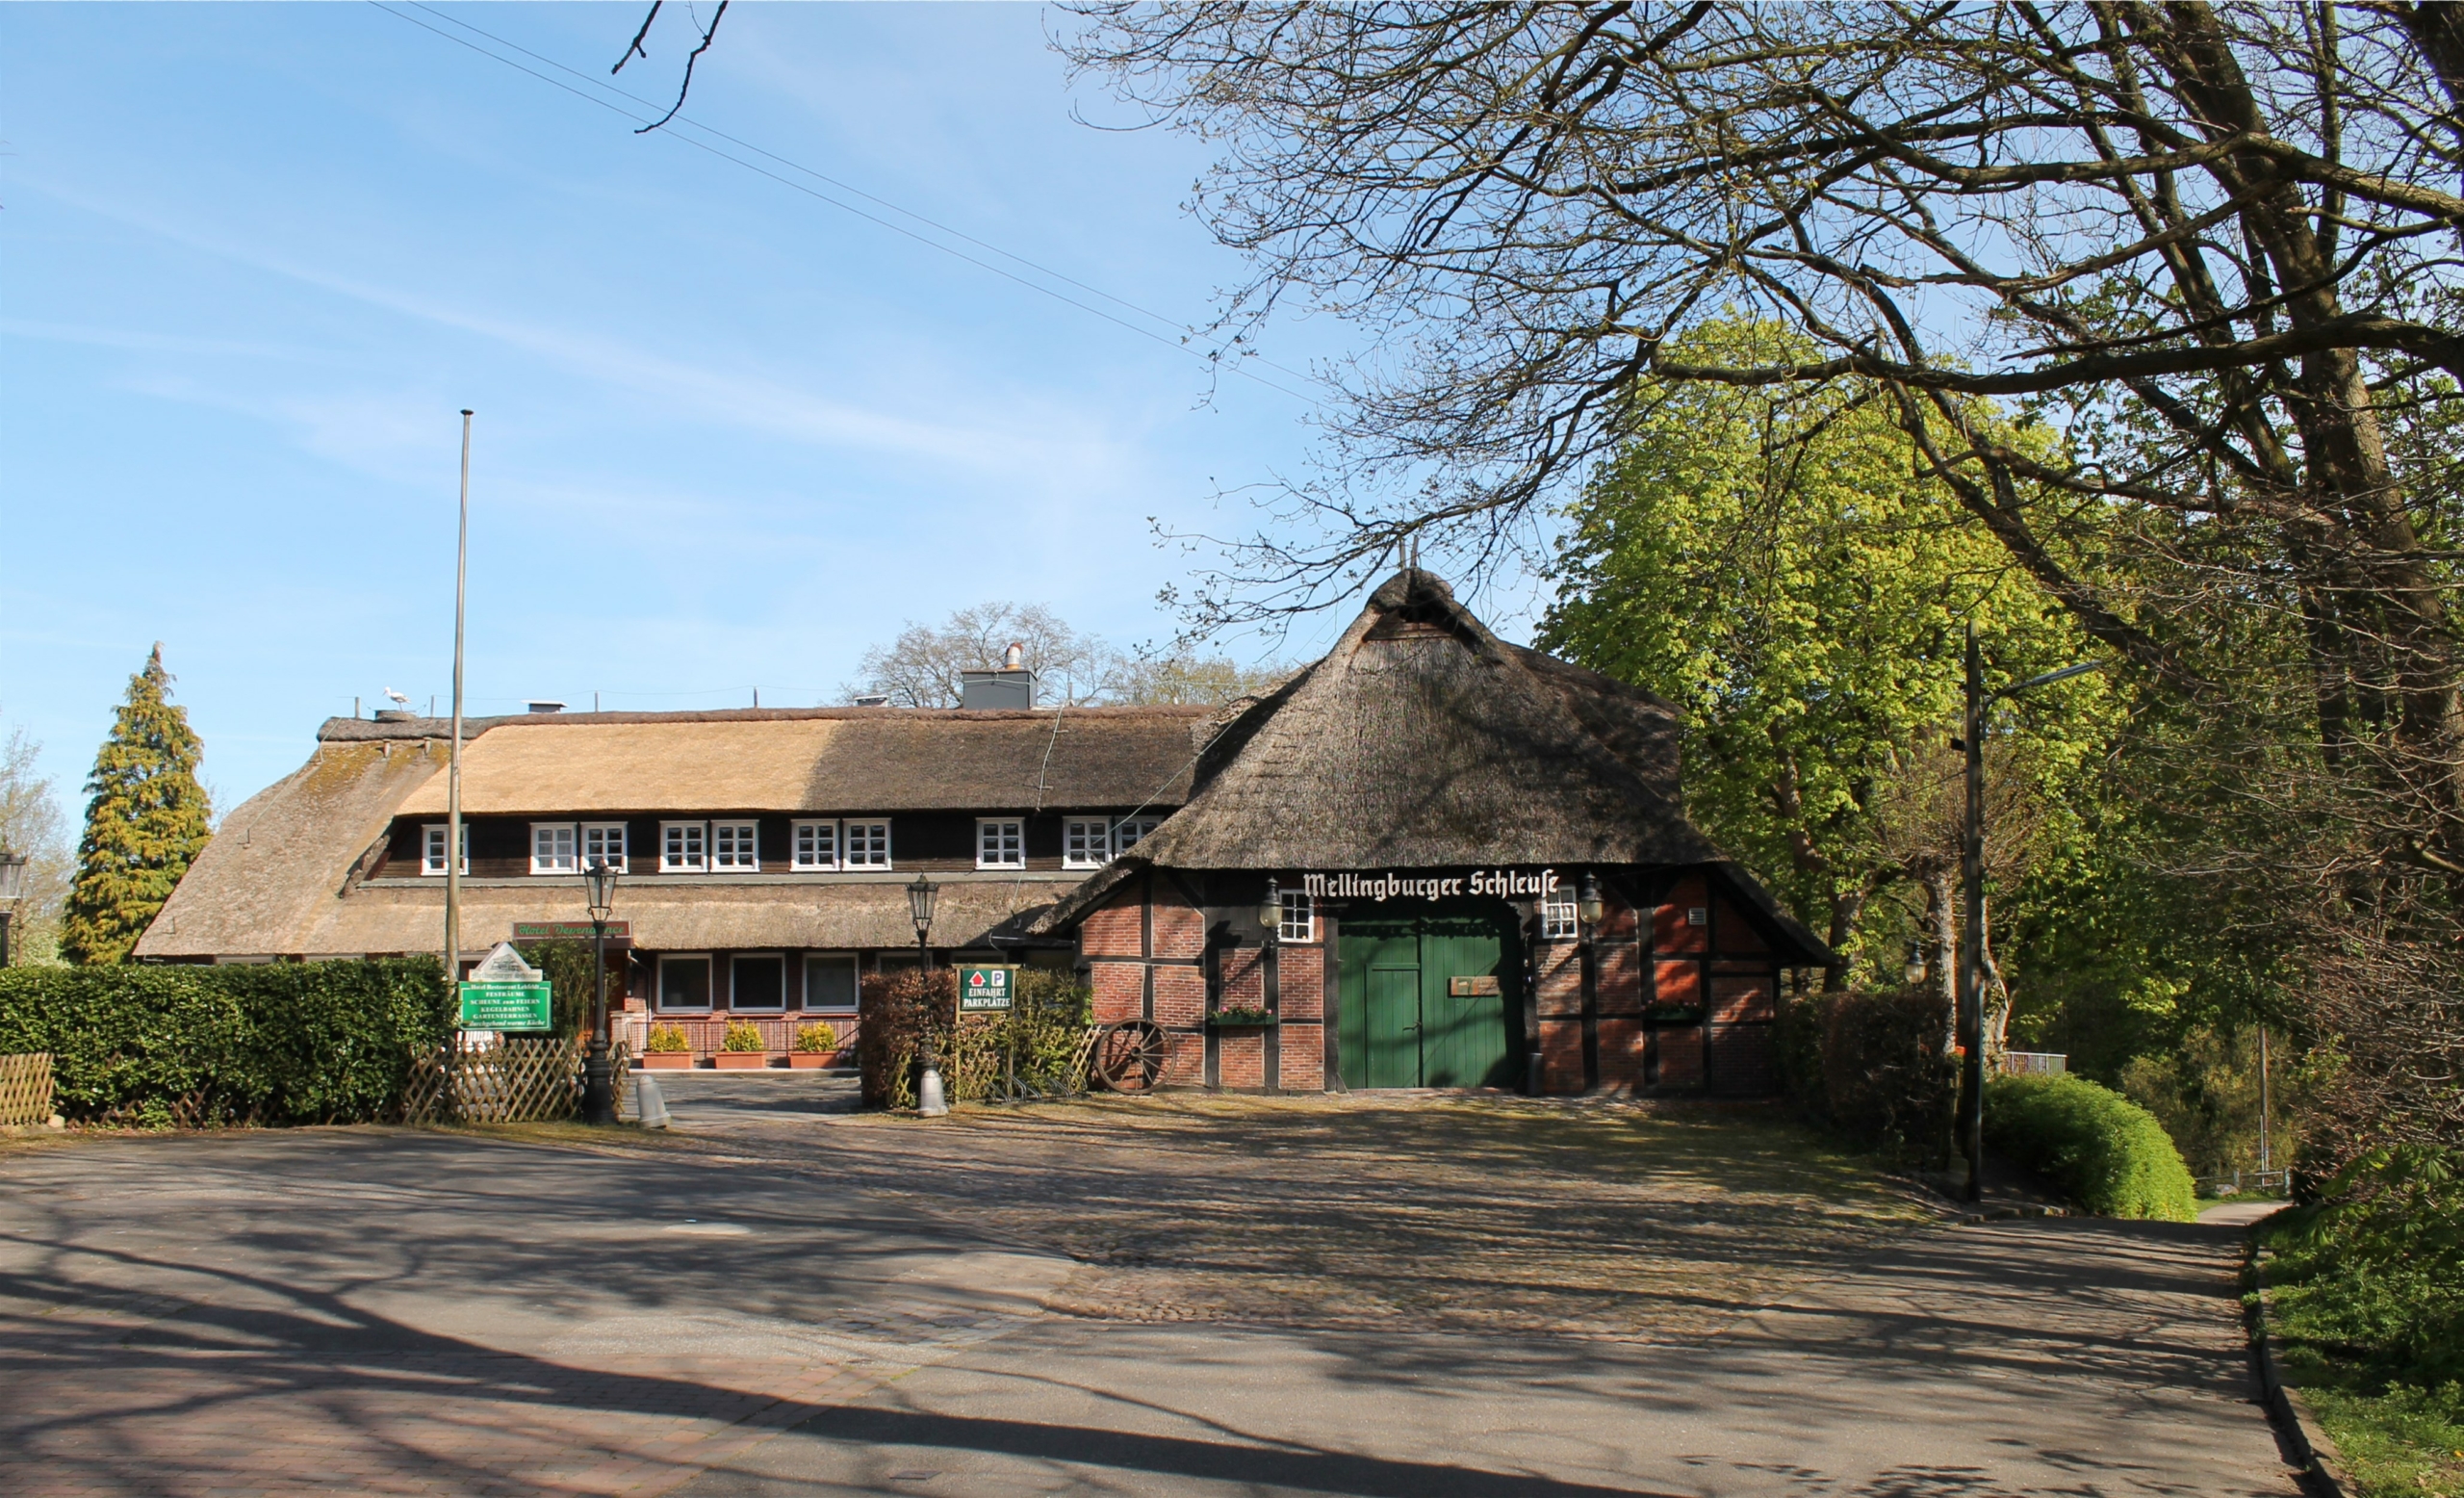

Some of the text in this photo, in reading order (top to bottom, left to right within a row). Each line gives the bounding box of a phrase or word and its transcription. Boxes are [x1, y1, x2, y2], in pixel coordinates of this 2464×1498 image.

[1303, 872, 1460, 901] Mellingburger
[518, 923, 625, 936] Hotel Dependnce
[968, 988, 1006, 997] EINFAHRT
[963, 996, 1011, 1008] PARKPLÄTZE
